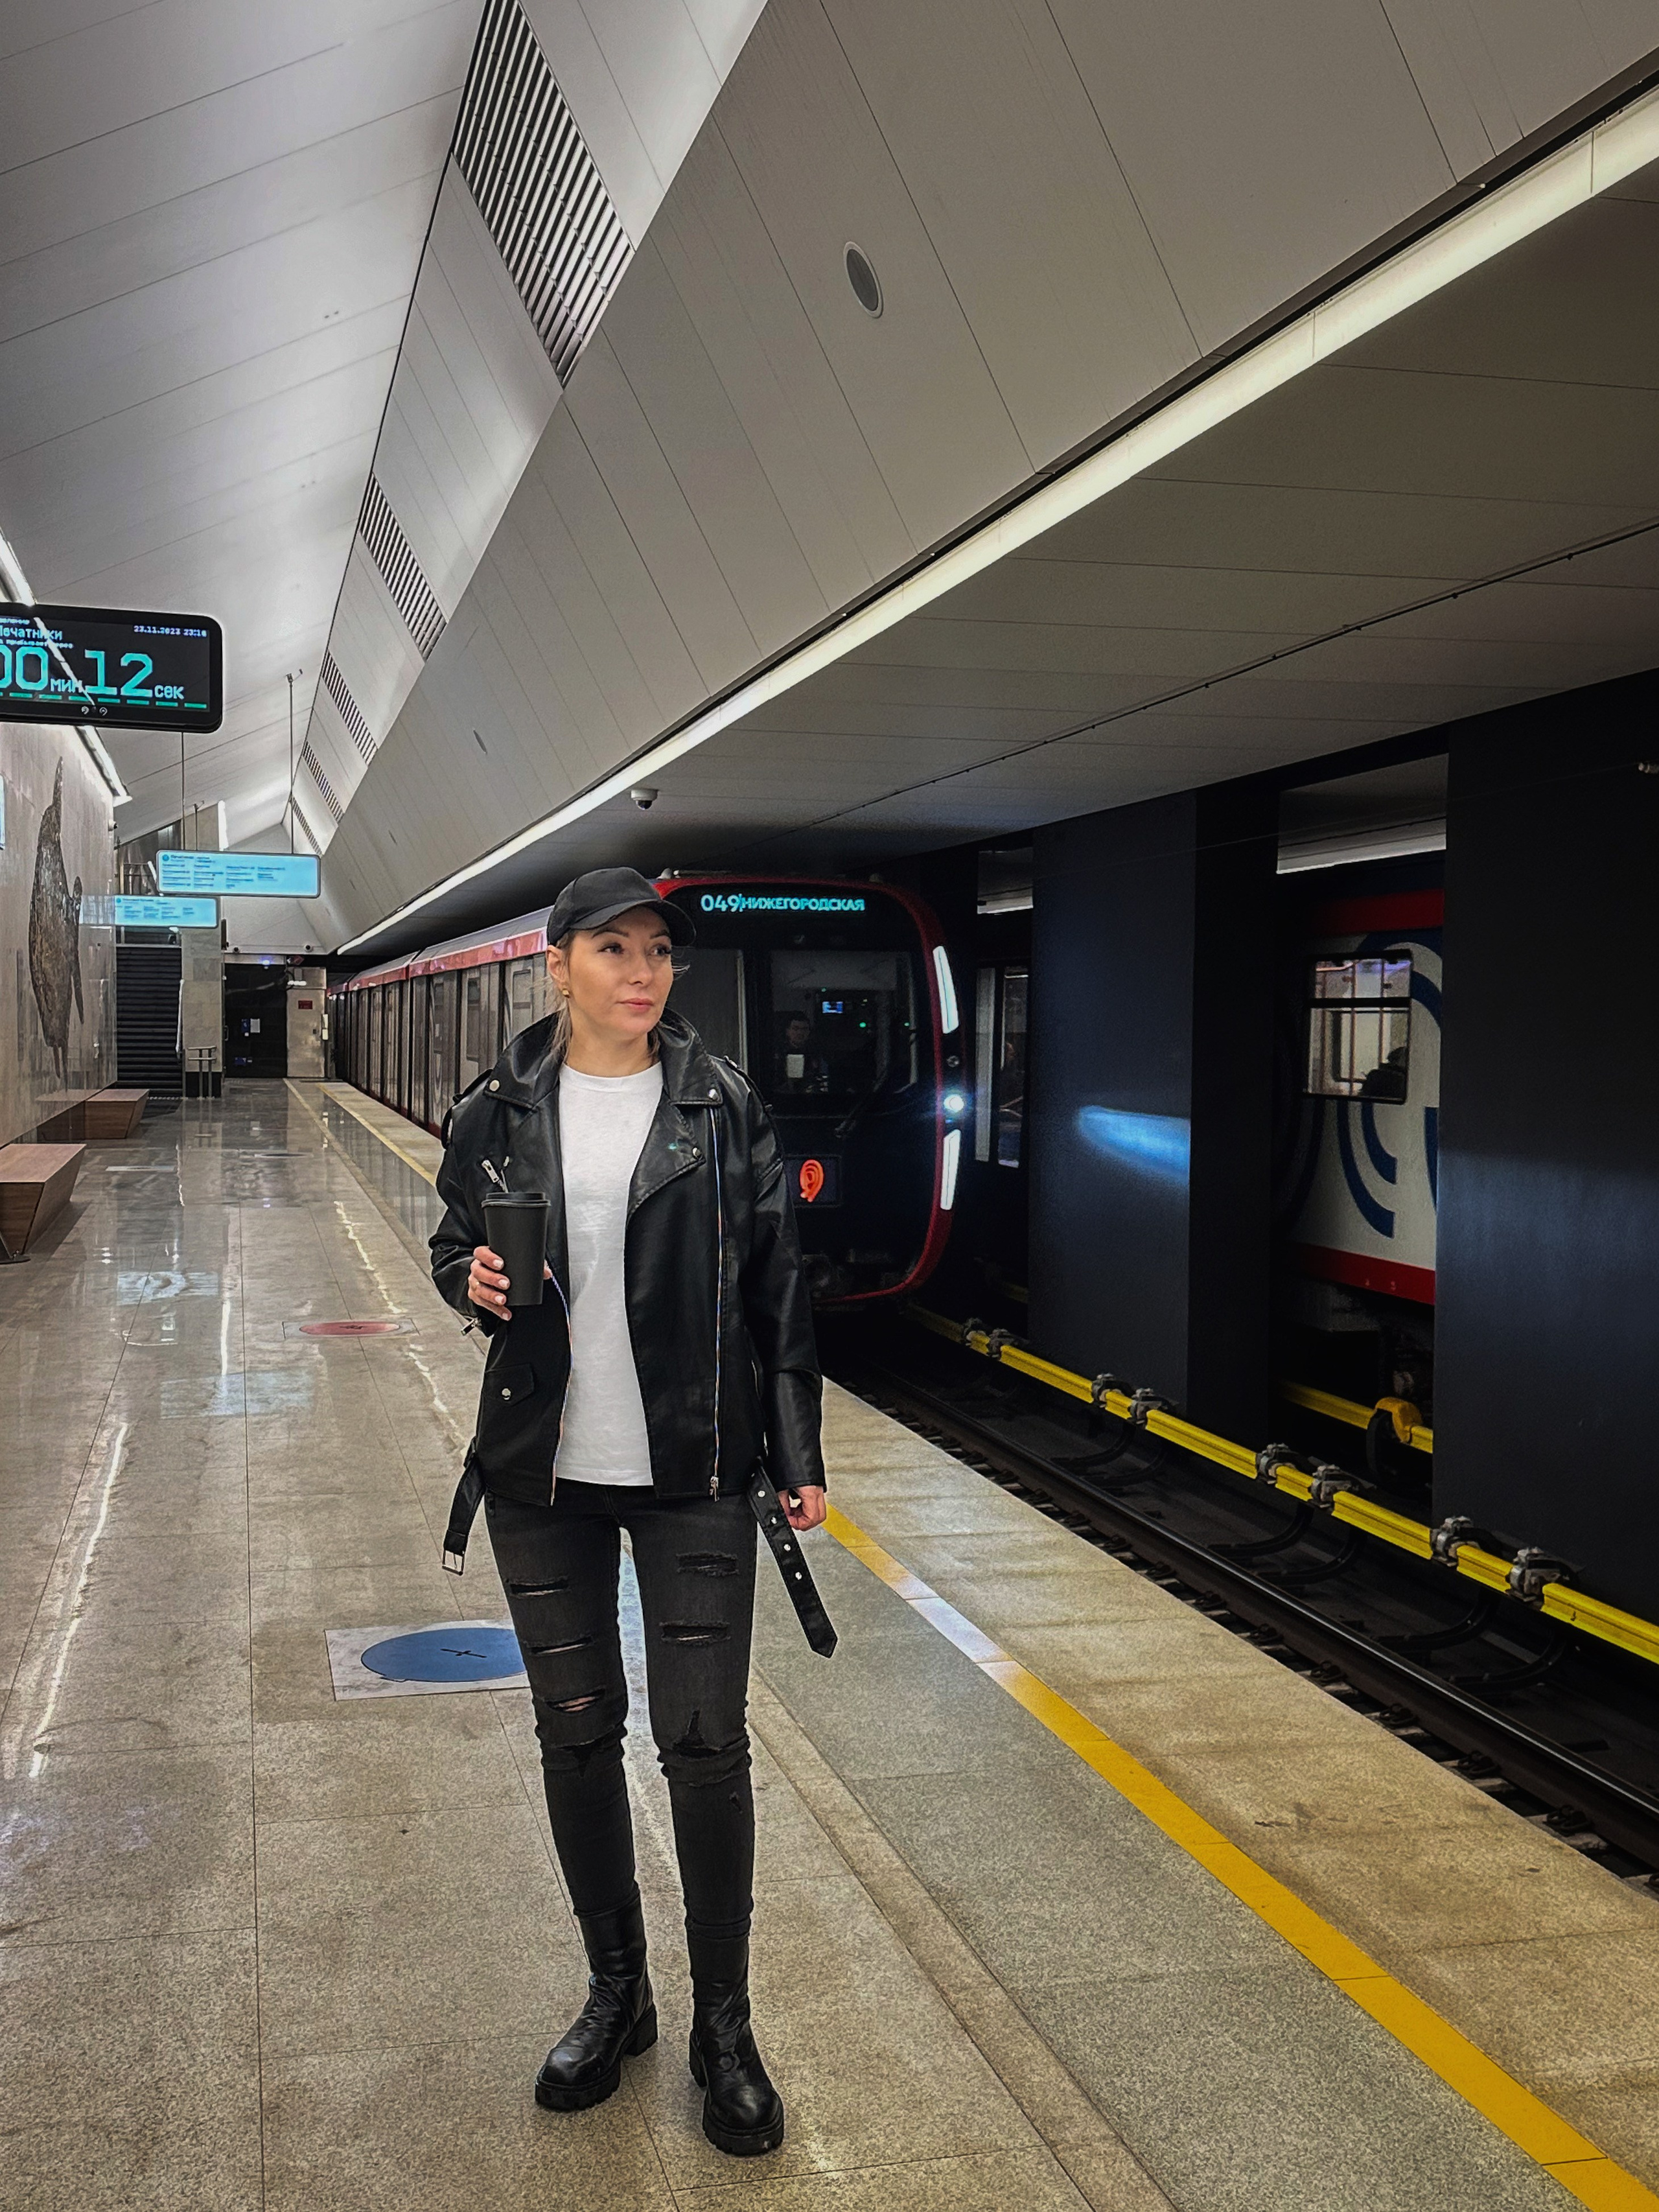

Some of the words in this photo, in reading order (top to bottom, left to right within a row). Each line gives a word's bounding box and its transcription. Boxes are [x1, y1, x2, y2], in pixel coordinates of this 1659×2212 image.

[85, 649, 153, 698] 12
[701, 894, 741, 912] 049
[741, 897, 865, 911] НИЖЕГОРОДСКАЯ
